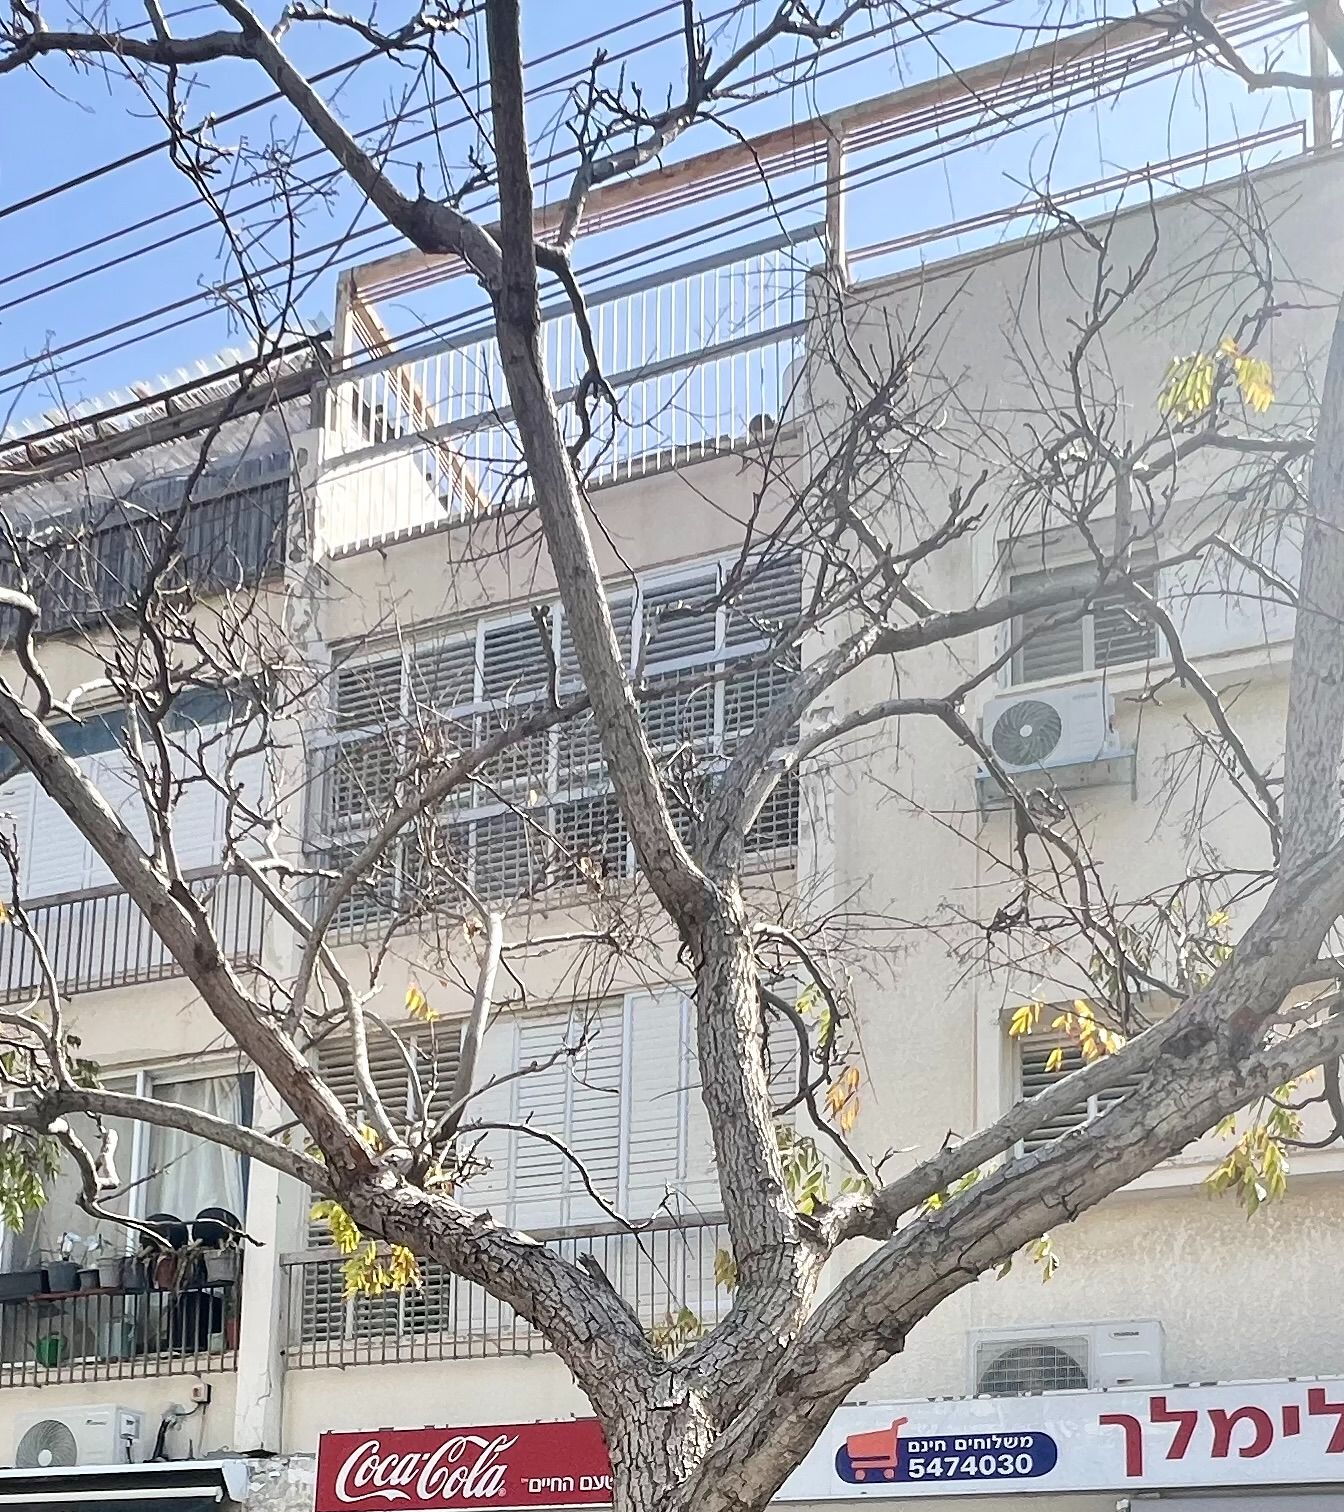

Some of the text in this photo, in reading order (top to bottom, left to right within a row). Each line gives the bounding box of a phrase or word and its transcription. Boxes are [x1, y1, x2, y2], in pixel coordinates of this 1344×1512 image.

[908, 1434, 1034, 1453] משלוחים חינם
[335, 1434, 520, 1503] Coca-Cola
[908, 1453, 1034, 1479] 5474030
[528, 1475, 614, 1493] טעם החיים
